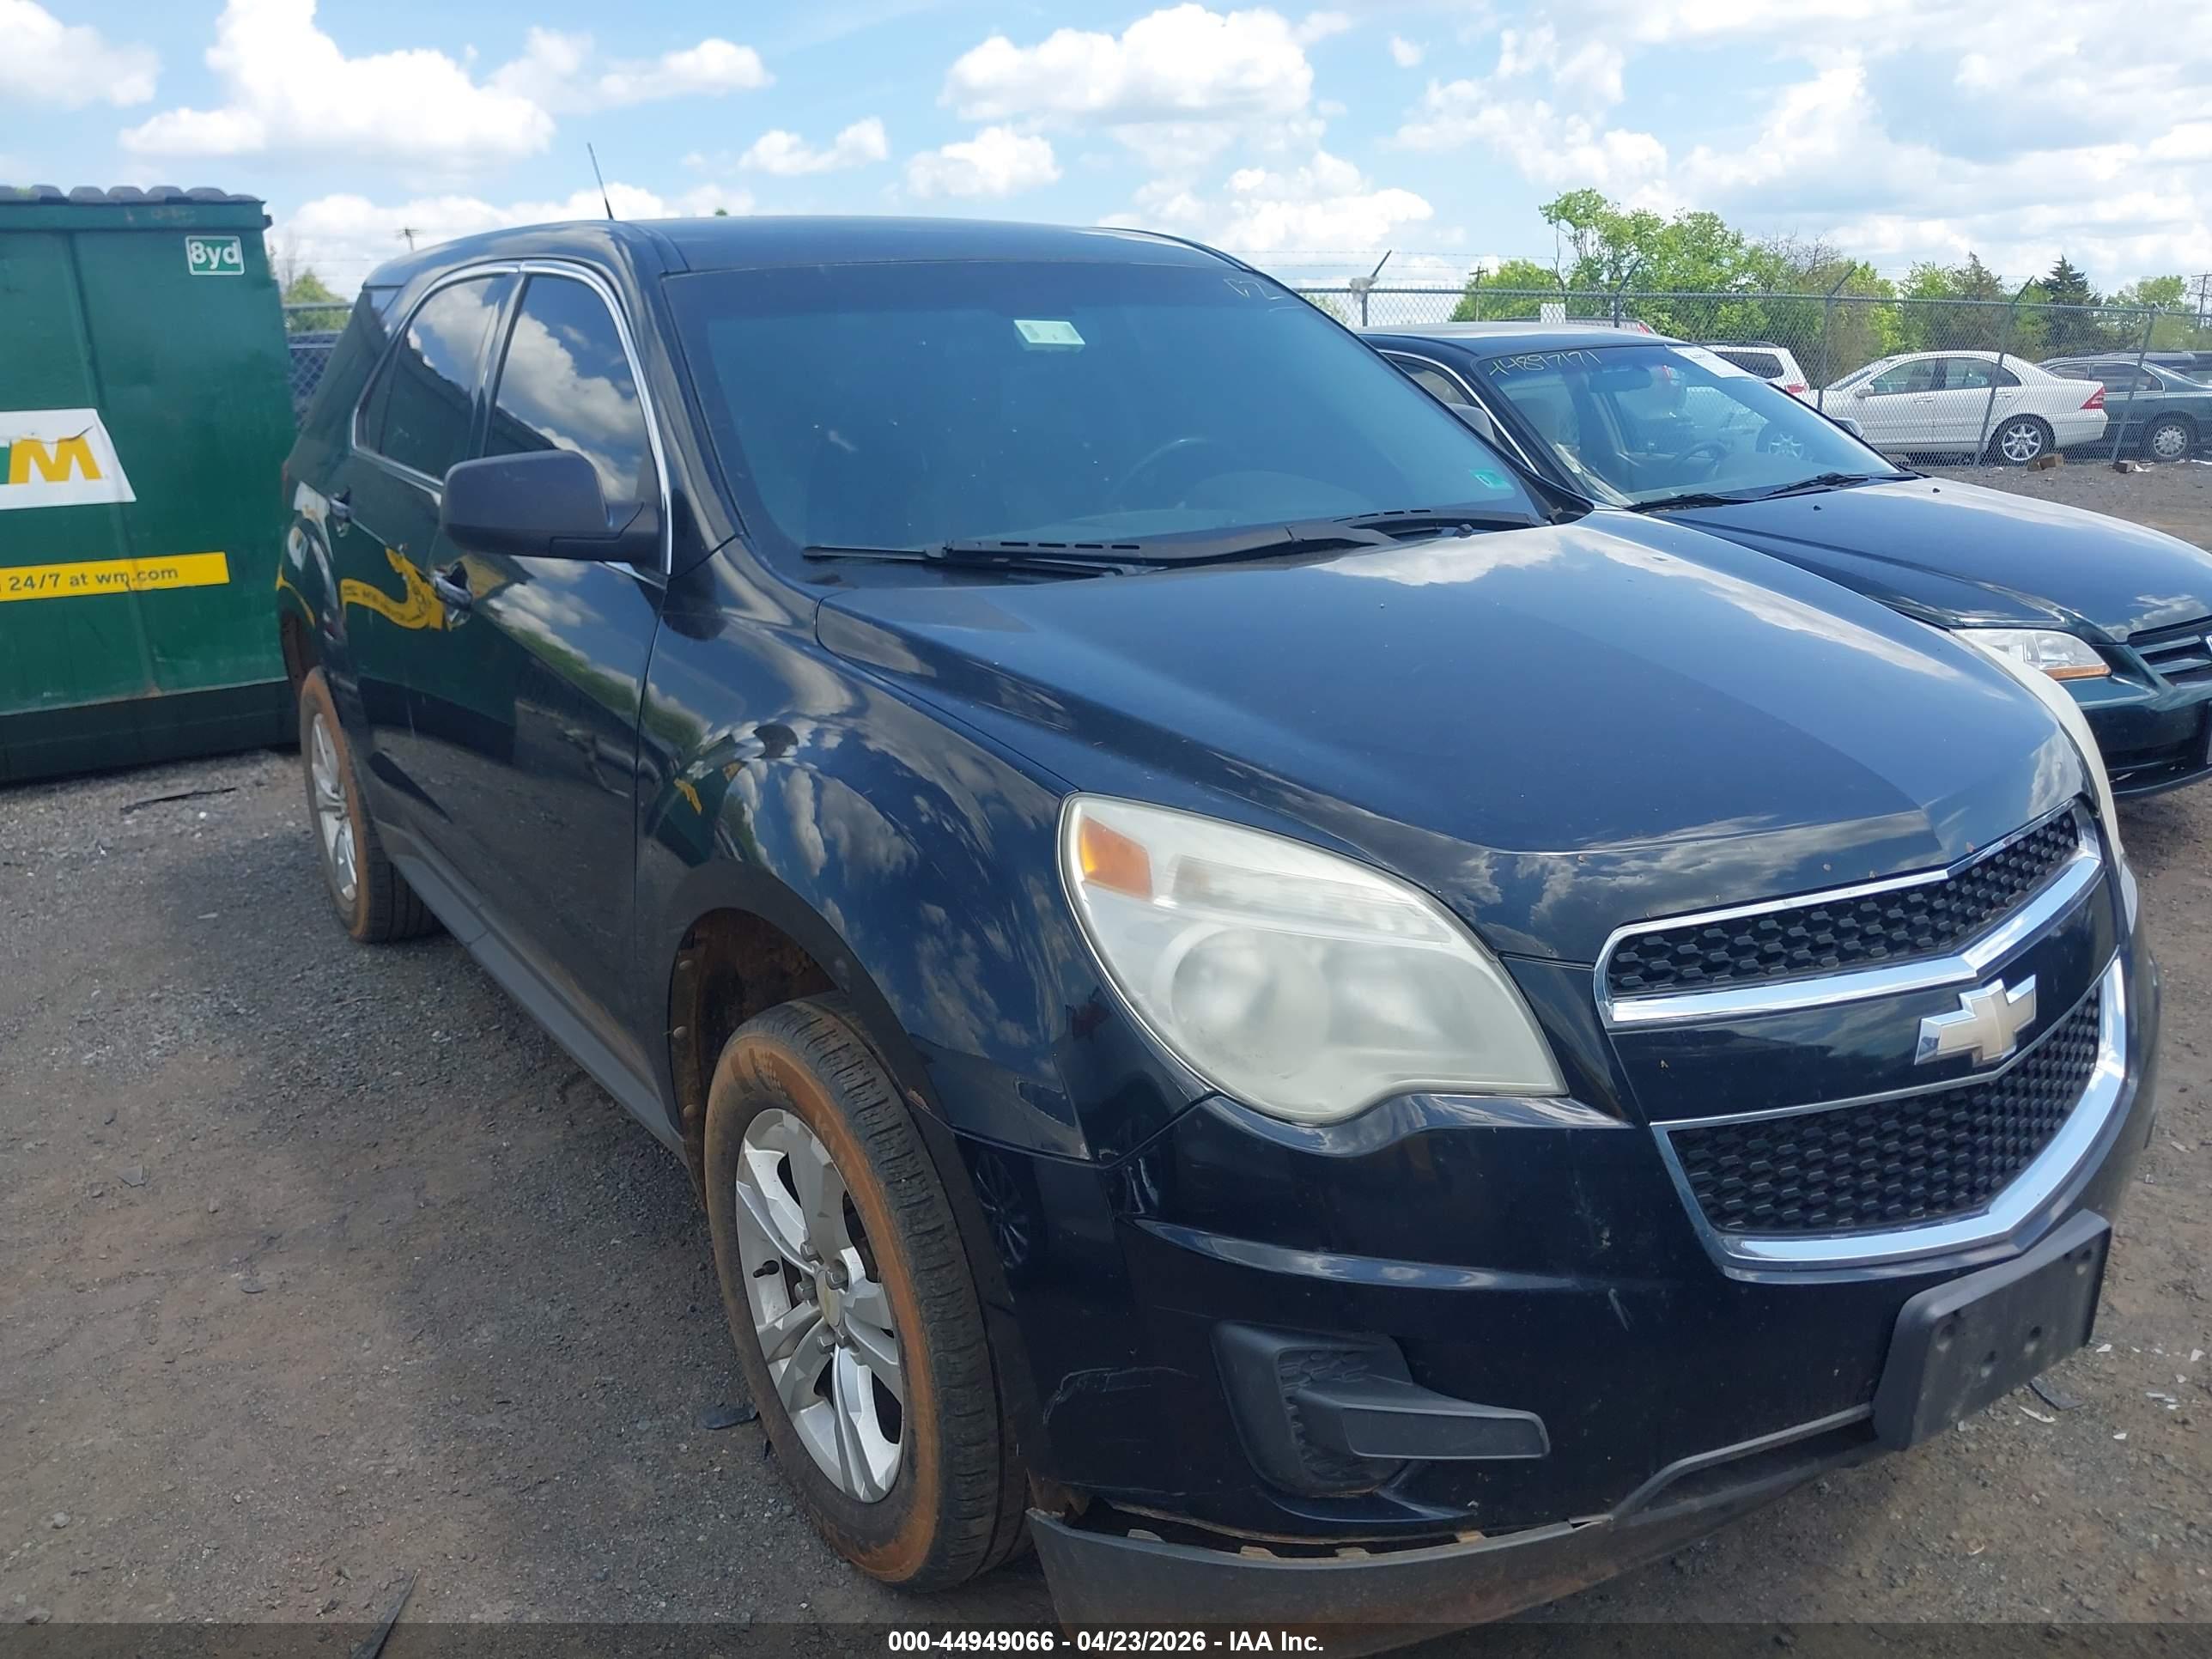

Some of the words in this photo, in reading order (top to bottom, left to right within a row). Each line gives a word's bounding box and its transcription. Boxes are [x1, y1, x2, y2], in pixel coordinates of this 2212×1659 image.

[191, 240, 240, 270] 8yd
[0, 434, 103, 485] M
[9, 573, 61, 591] 24/7
[70, 572, 89, 587] at
[95, 567, 179, 587] wm.com
